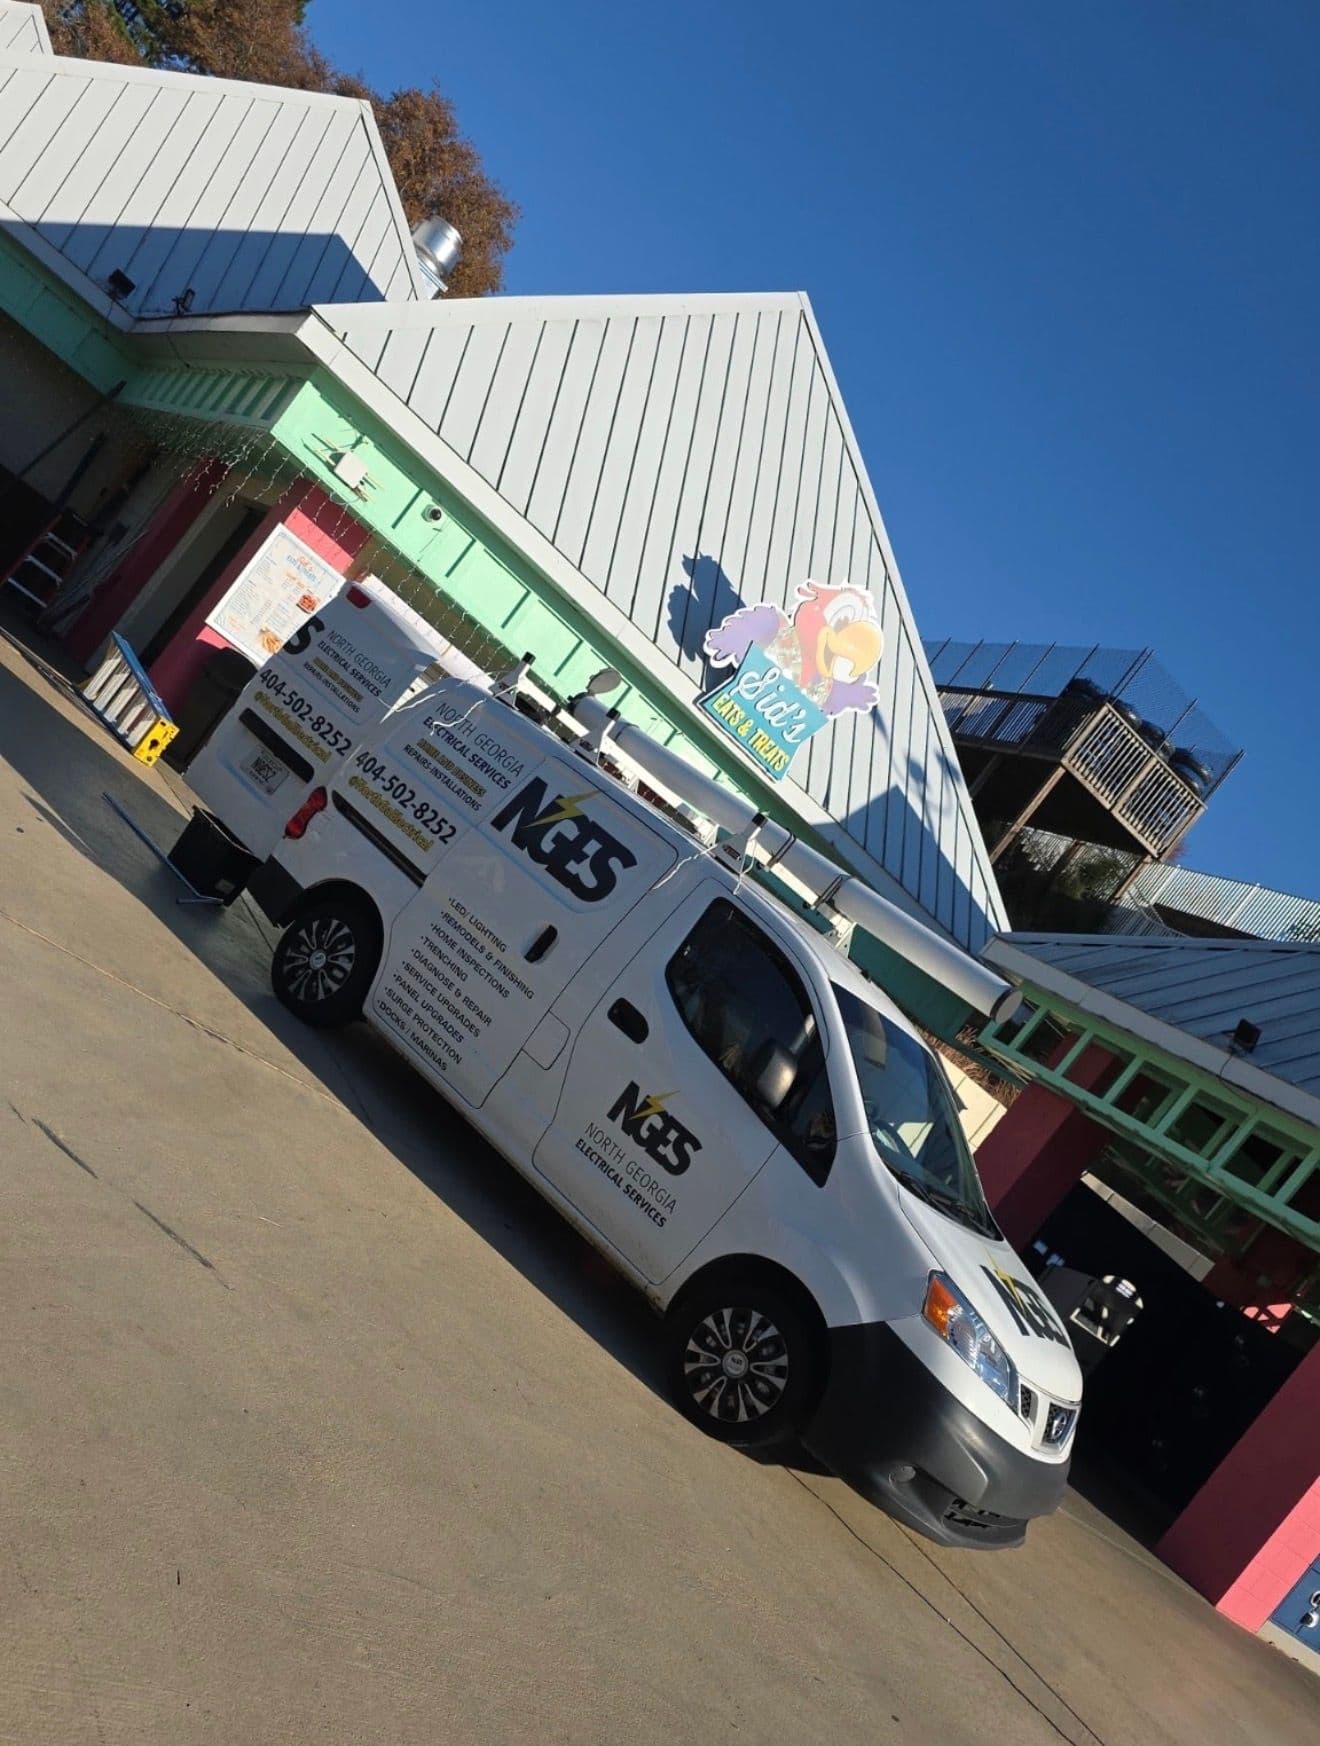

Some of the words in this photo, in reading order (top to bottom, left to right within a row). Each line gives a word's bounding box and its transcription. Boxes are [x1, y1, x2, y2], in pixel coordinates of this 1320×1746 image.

[318, 640, 351, 672] ELECTRICAL
[350, 668, 382, 697] SERVICES
[328, 630, 357, 656] NORTH
[354, 653, 391, 688] GEORGIA
[260, 668, 352, 757] 404-502-8252
[436, 702, 477, 738] NORTH
[474, 733, 524, 777] GEORGIA
[712, 693, 746, 727] EATS
[737, 719, 754, 737] &
[748, 727, 790, 771] TREATS
[729, 666, 807, 743] Sid's
[355, 751, 457, 845] 404-502-8252
[468, 753, 512, 789] SERVICES
[490, 775, 638, 902] NGES
[422, 936, 468, 982] TRENCHING
[431, 924, 458, 950] HOME
[457, 947, 510, 999] INSPECTIONS
[442, 912, 486, 953] REMODELS
[485, 952, 494, 961] &
[493, 959, 535, 999] FINISHING
[469, 915, 507, 953] LIGHTING
[386, 988, 414, 1016] SURGE
[412, 1014, 463, 1064] PROTECTION
[394, 975, 420, 1003] PANEL
[421, 1000, 464, 1044] UPGRADES
[403, 962, 438, 996] SERVICE
[437, 993, 480, 1038] UPGRADES
[412, 950, 455, 991] DIAGNOSE
[454, 988, 462, 998] &
[462, 996, 493, 1027] REPAIR
[379, 1000, 406, 1031] DOCKS
[410, 1032, 448, 1071] MARINAS
[606, 1080, 703, 1177] NGES
[575, 1138, 625, 1188] ELECTRICAL
[623, 1183, 667, 1228] SERVICES
[585, 1122, 626, 1164] NORTH
[625, 1160, 677, 1214] GEORGIA
